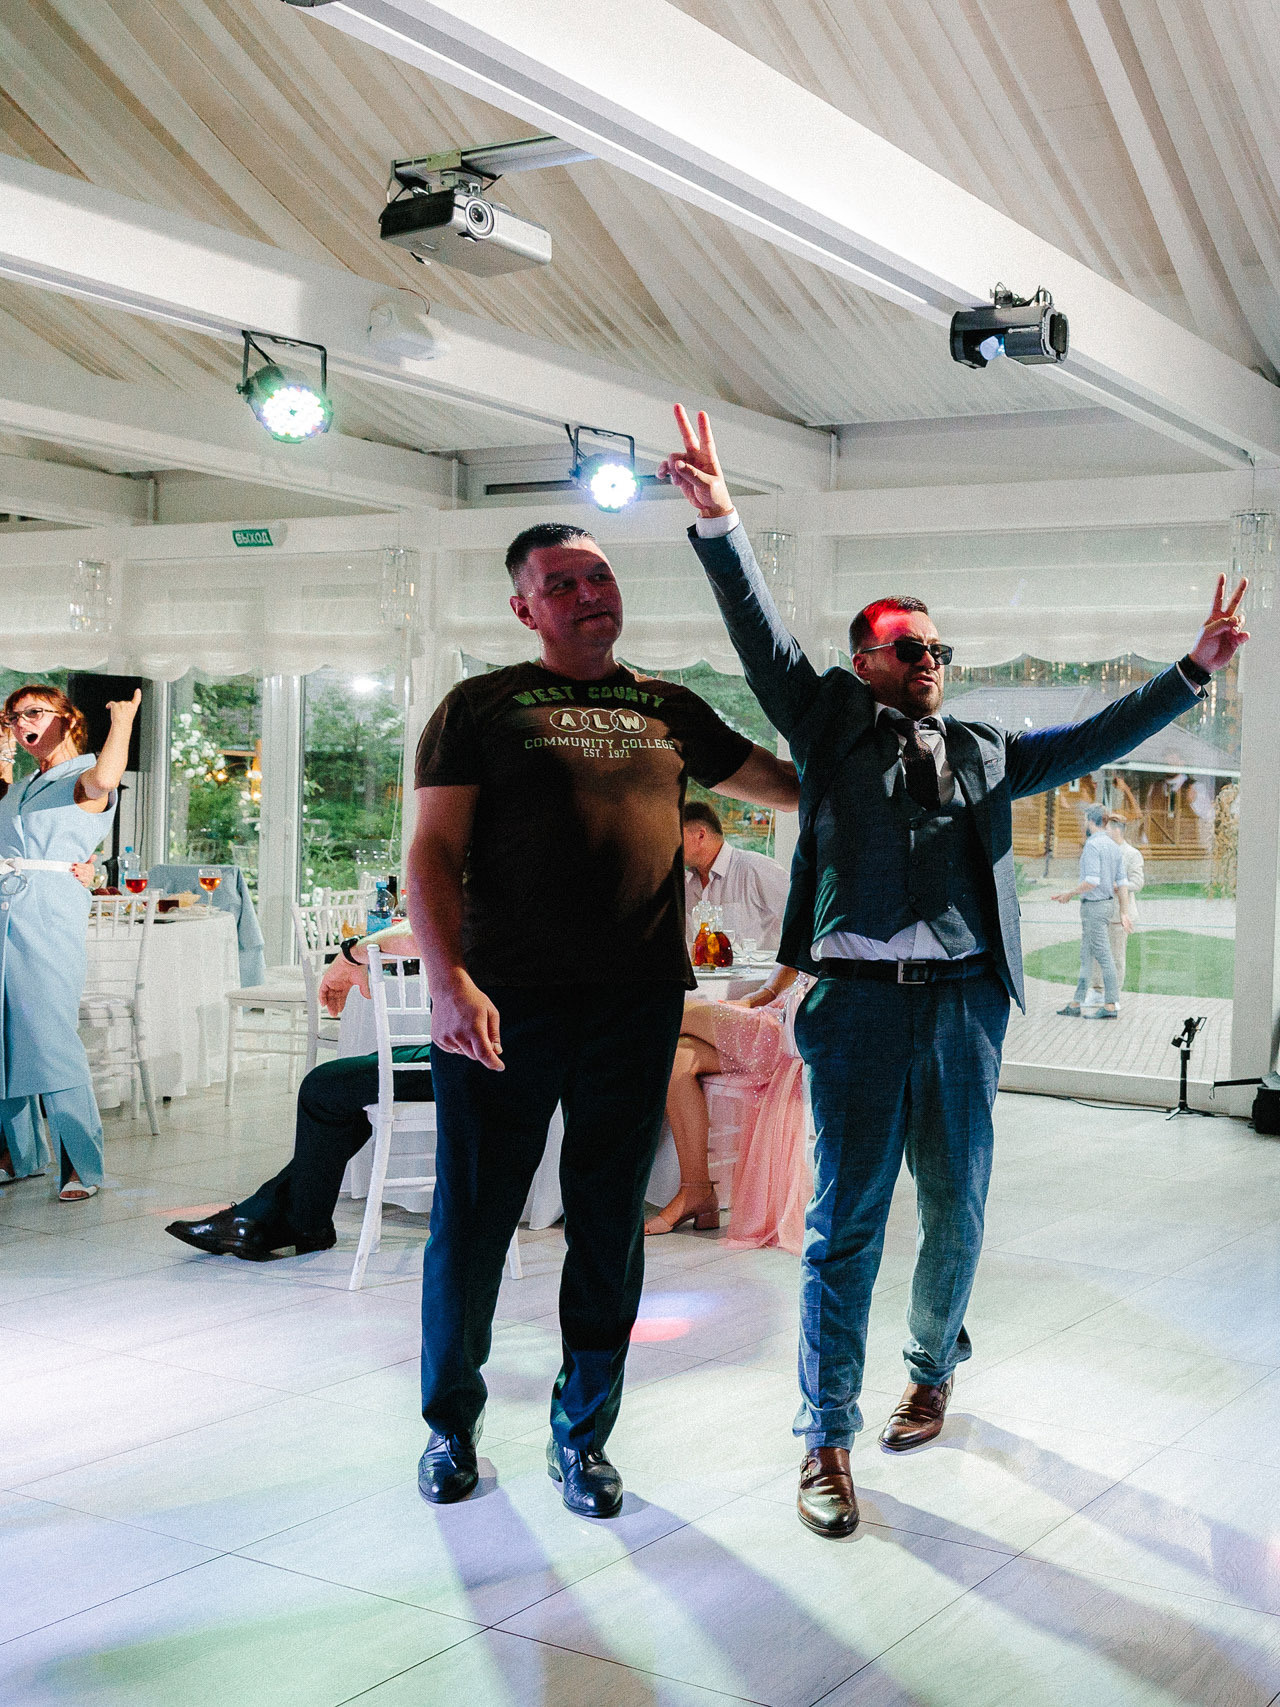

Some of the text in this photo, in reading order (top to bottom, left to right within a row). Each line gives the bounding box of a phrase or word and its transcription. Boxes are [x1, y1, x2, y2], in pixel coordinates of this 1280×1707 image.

[235, 532, 270, 544] ВЫХОД
[513, 686, 665, 708] WEST COUNTY
[524, 737, 675, 750] COMMUNITY COLLEGE
[583, 748, 631, 759] EST. 1971
